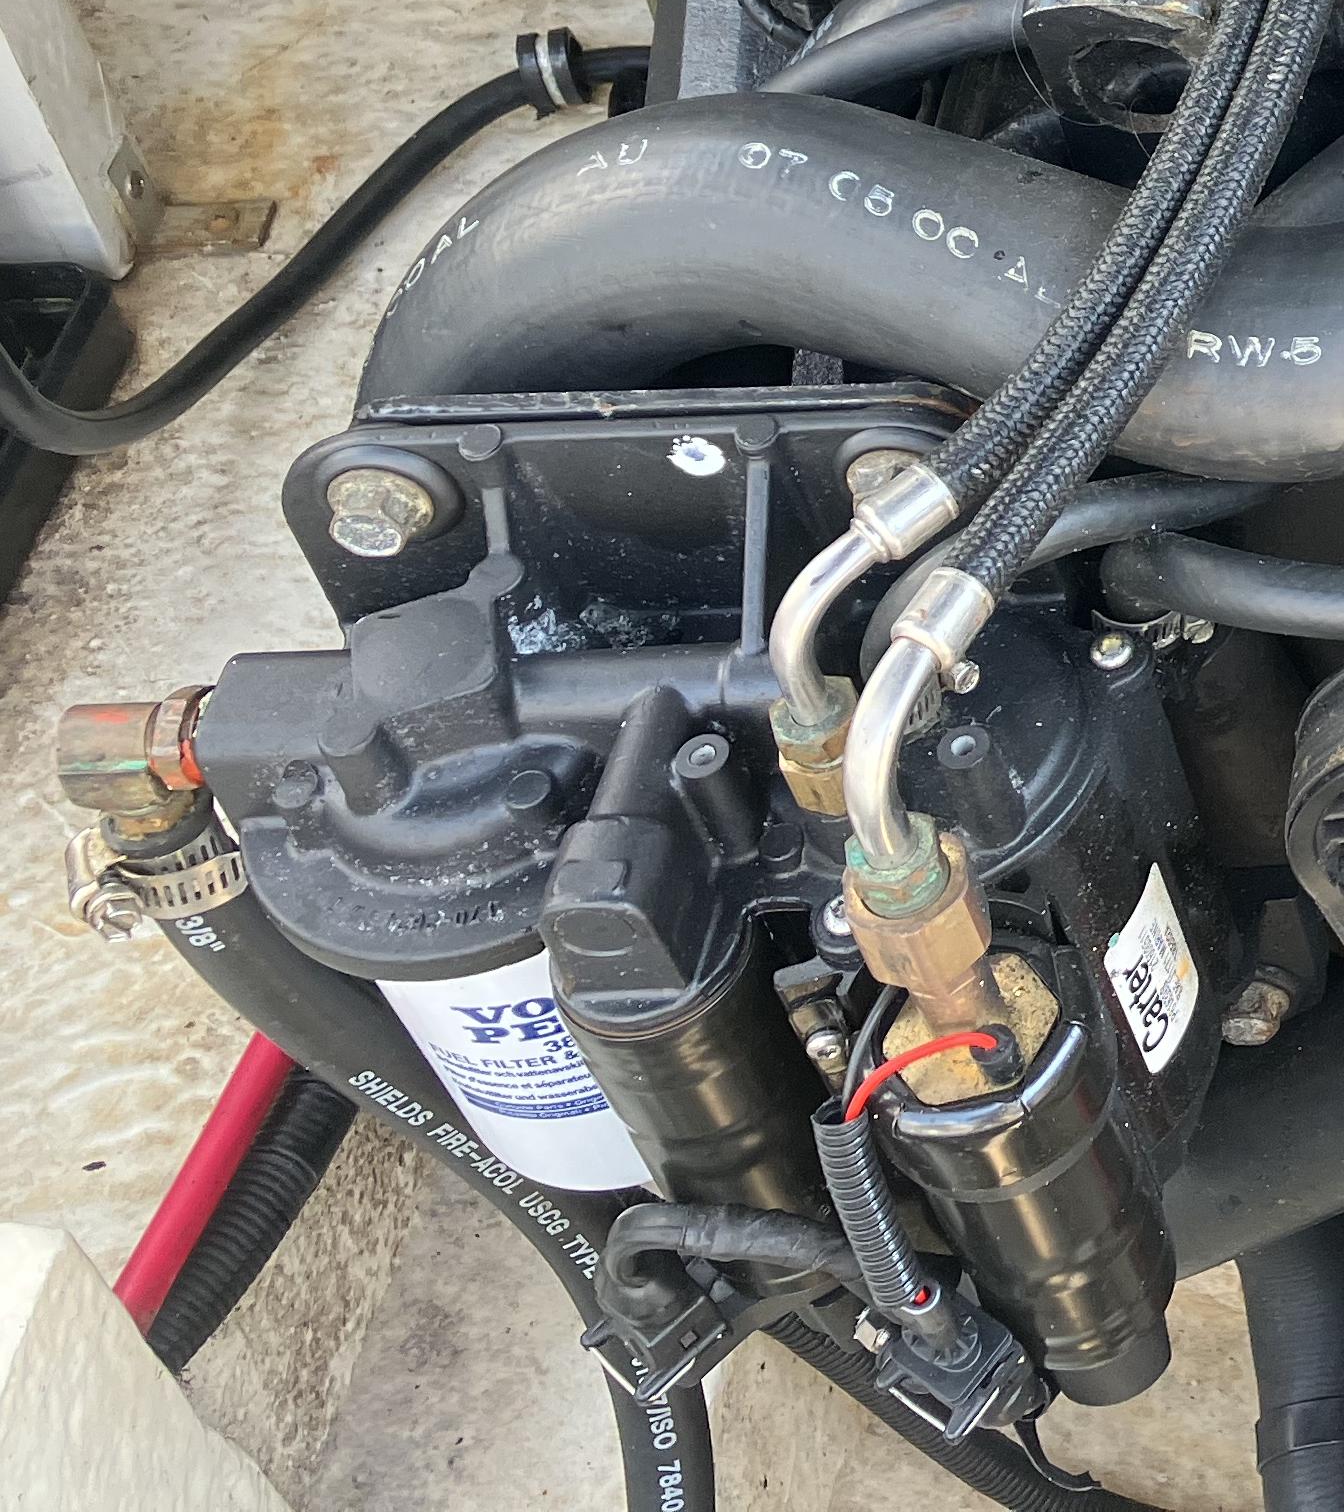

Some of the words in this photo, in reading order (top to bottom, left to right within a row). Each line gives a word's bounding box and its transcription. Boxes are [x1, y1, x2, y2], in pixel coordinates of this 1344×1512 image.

[575, 138, 649, 178] AU
[174, 912, 227, 955] 3/8"
[449, 996, 556, 1025] VO
[1121, 953, 1169, 1053] Carter
[462, 1014, 566, 1044] PE
[428, 1041, 477, 1066] FUEL
[478, 1054, 557, 1069] FILTER
[349, 1068, 435, 1128] SHIELDS
[426, 1120, 525, 1198] FIRE-ACOL
[517, 1192, 566, 1236] USCG
